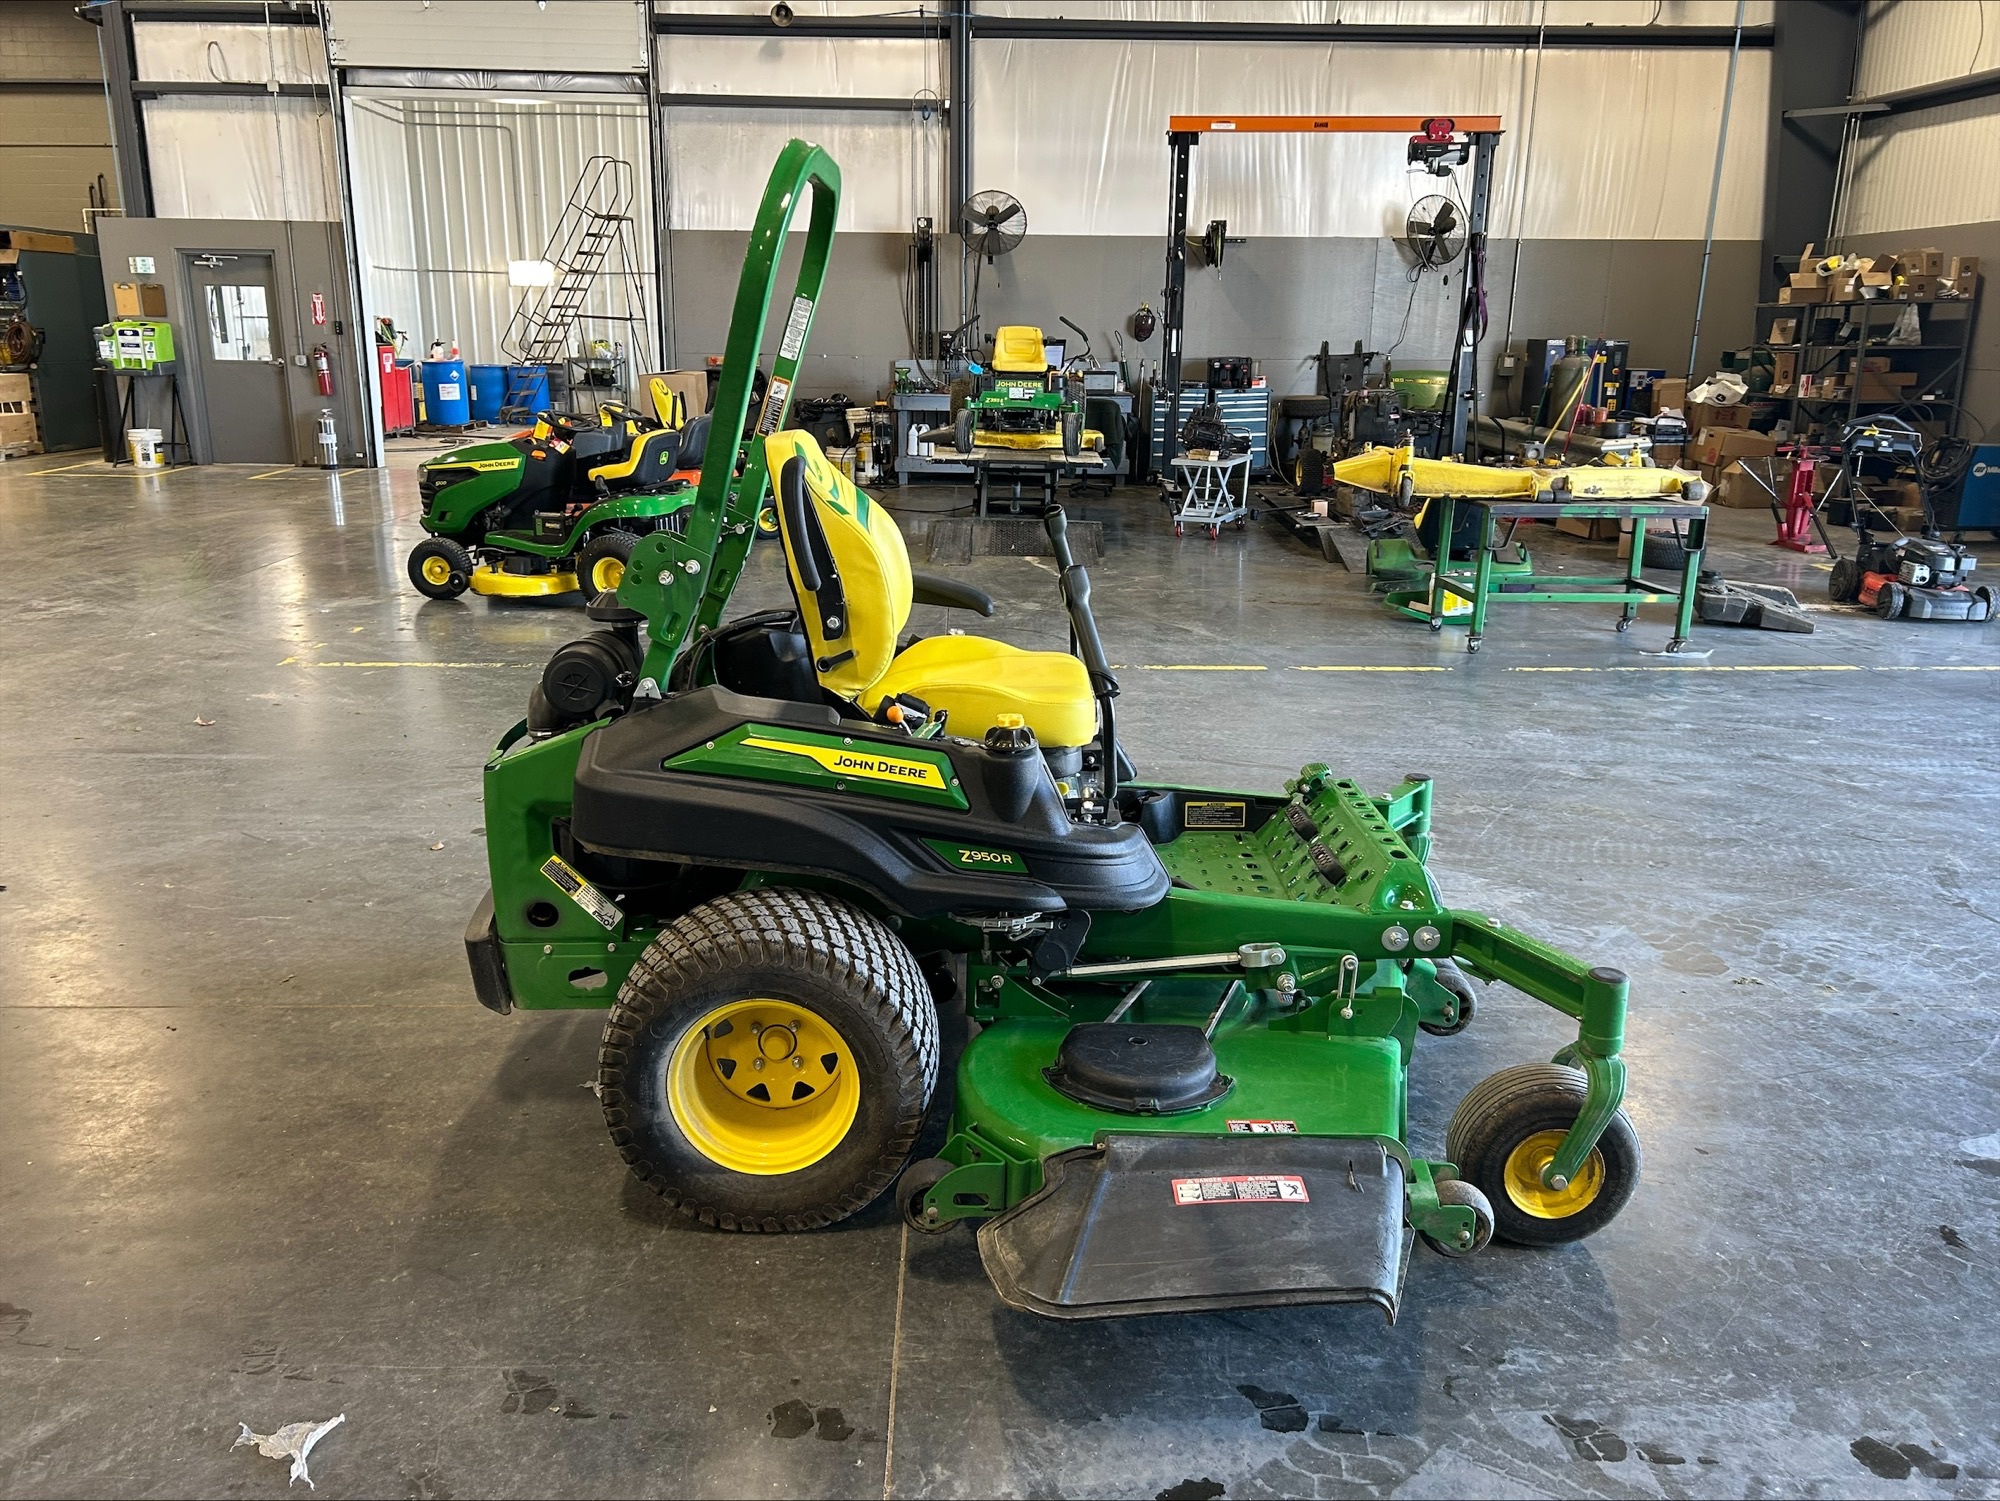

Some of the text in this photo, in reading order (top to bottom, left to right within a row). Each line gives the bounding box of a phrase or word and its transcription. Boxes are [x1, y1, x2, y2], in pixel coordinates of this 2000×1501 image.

[495, 460, 515, 468] DEERE
[833, 755, 928, 779] JOHN DEERE
[958, 849, 1013, 865] Z950R
